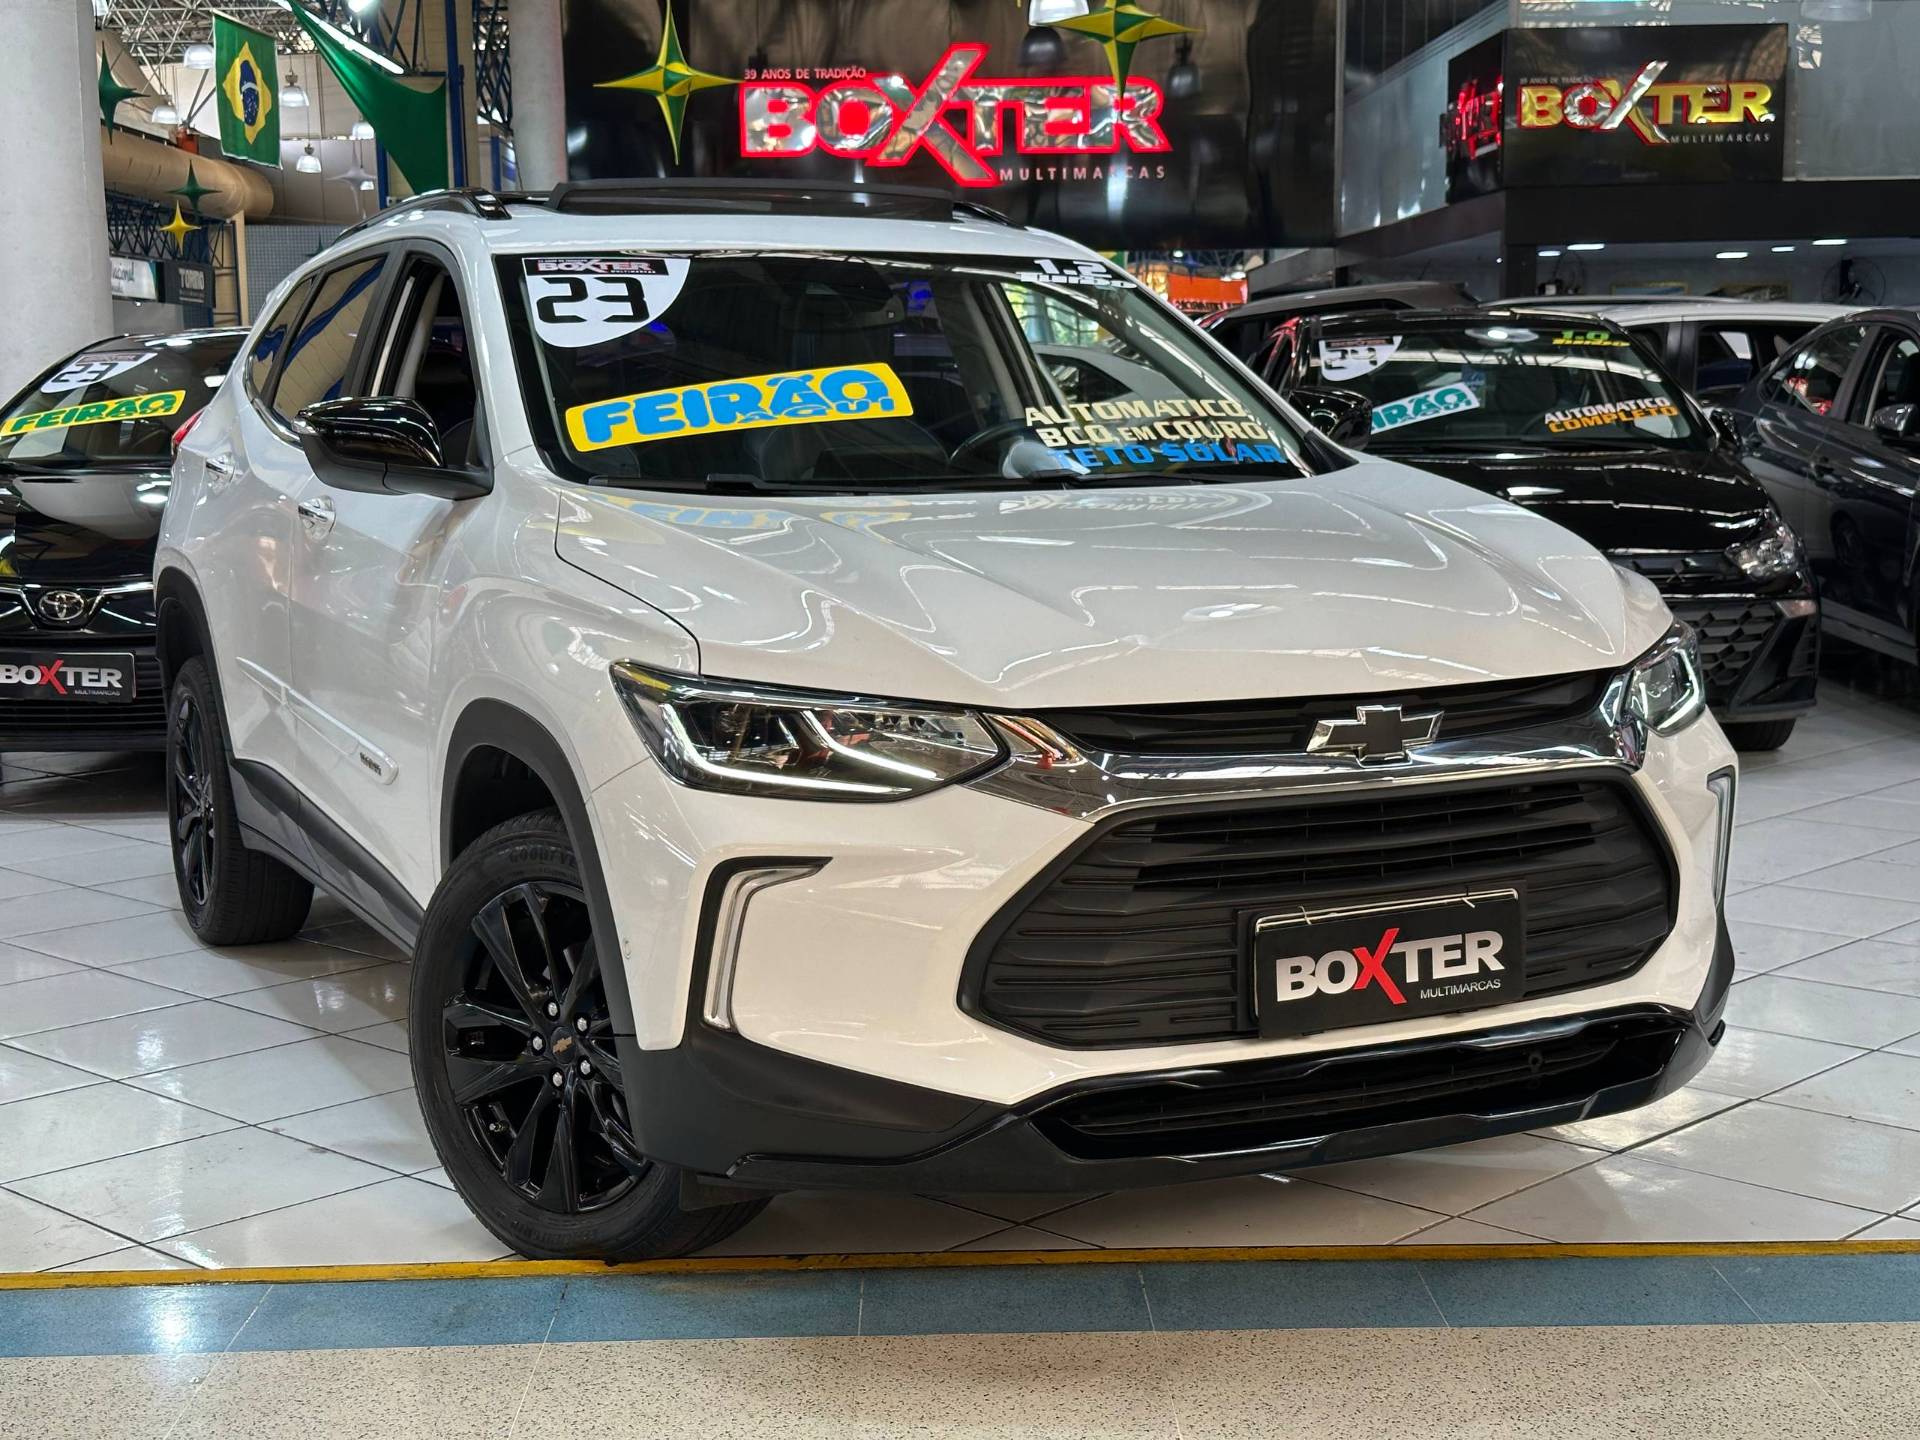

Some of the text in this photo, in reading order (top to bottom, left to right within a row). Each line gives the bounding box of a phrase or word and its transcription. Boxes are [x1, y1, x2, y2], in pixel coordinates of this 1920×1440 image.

[744, 66, 866, 80] 39 ANOS DE TRADIÇÃO
[1518, 59, 1776, 145] BOXTER
[739, 43, 1172, 187] BOXTER
[1671, 133, 1770, 144] MULTIMARCAS
[1000, 166, 1165, 181] MULTIMARCAS
[538, 258, 654, 274] BOXTER
[1034, 259, 1113, 279] 1.2
[536, 277, 650, 323] 23
[51, 362, 118, 383] 23
[582, 369, 890, 443] FEIRÃO
[1371, 388, 1468, 430] IRÃO
[1122, 426, 1157, 441] EM
[1153, 420, 1268, 440] COURO
[1549, 406, 1679, 433] COMPLETO
[1050, 443, 1287, 468] TETO SOLAR
[0, 660, 123, 694] BOXTER
[1276, 927, 1505, 1005] BOXTER
[1420, 978, 1501, 999] MULTIMARCAS
